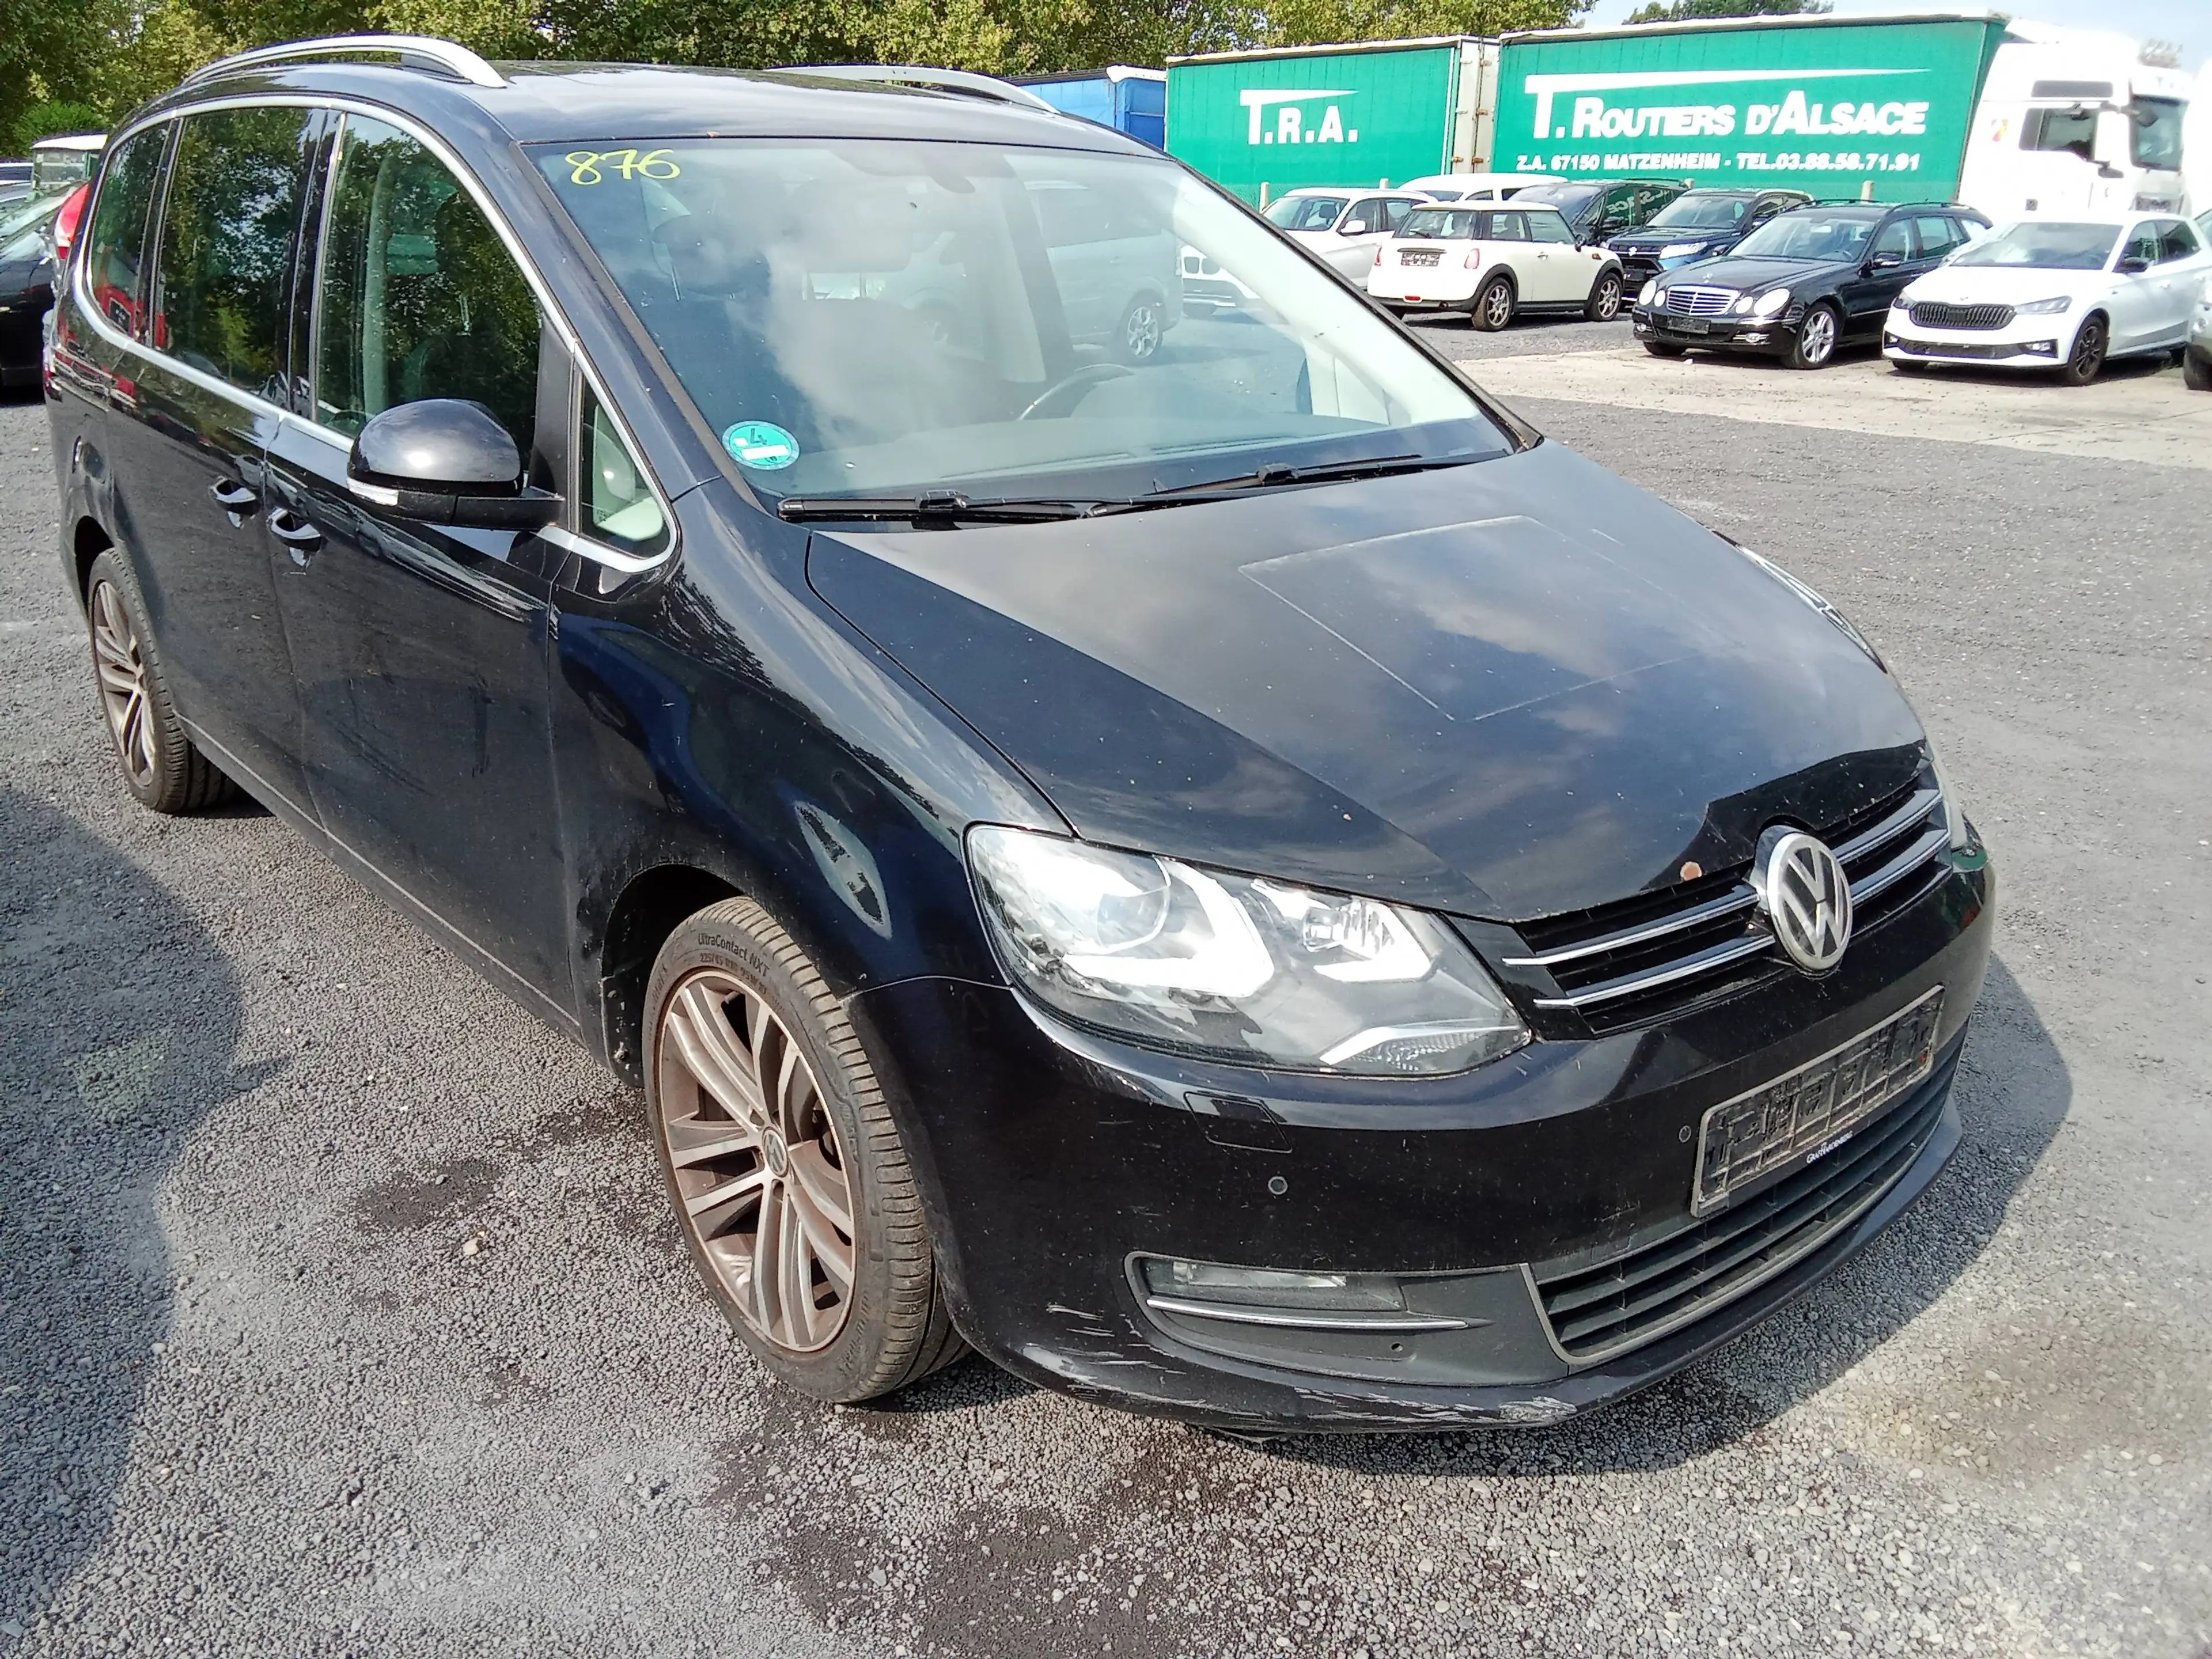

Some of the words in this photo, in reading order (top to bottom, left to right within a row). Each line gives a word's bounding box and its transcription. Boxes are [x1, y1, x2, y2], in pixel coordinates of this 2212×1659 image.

[1240, 89, 1358, 145] T.R.A.
[565, 149, 681, 185] 876
[1516, 154, 1547, 171] Z.A.
[1551, 154, 1600, 171] 67150
[1604, 153, 1721, 171] MATZENHEIM
[698, 932, 748, 961] UltraContact
[749, 953, 771, 977] NXT
